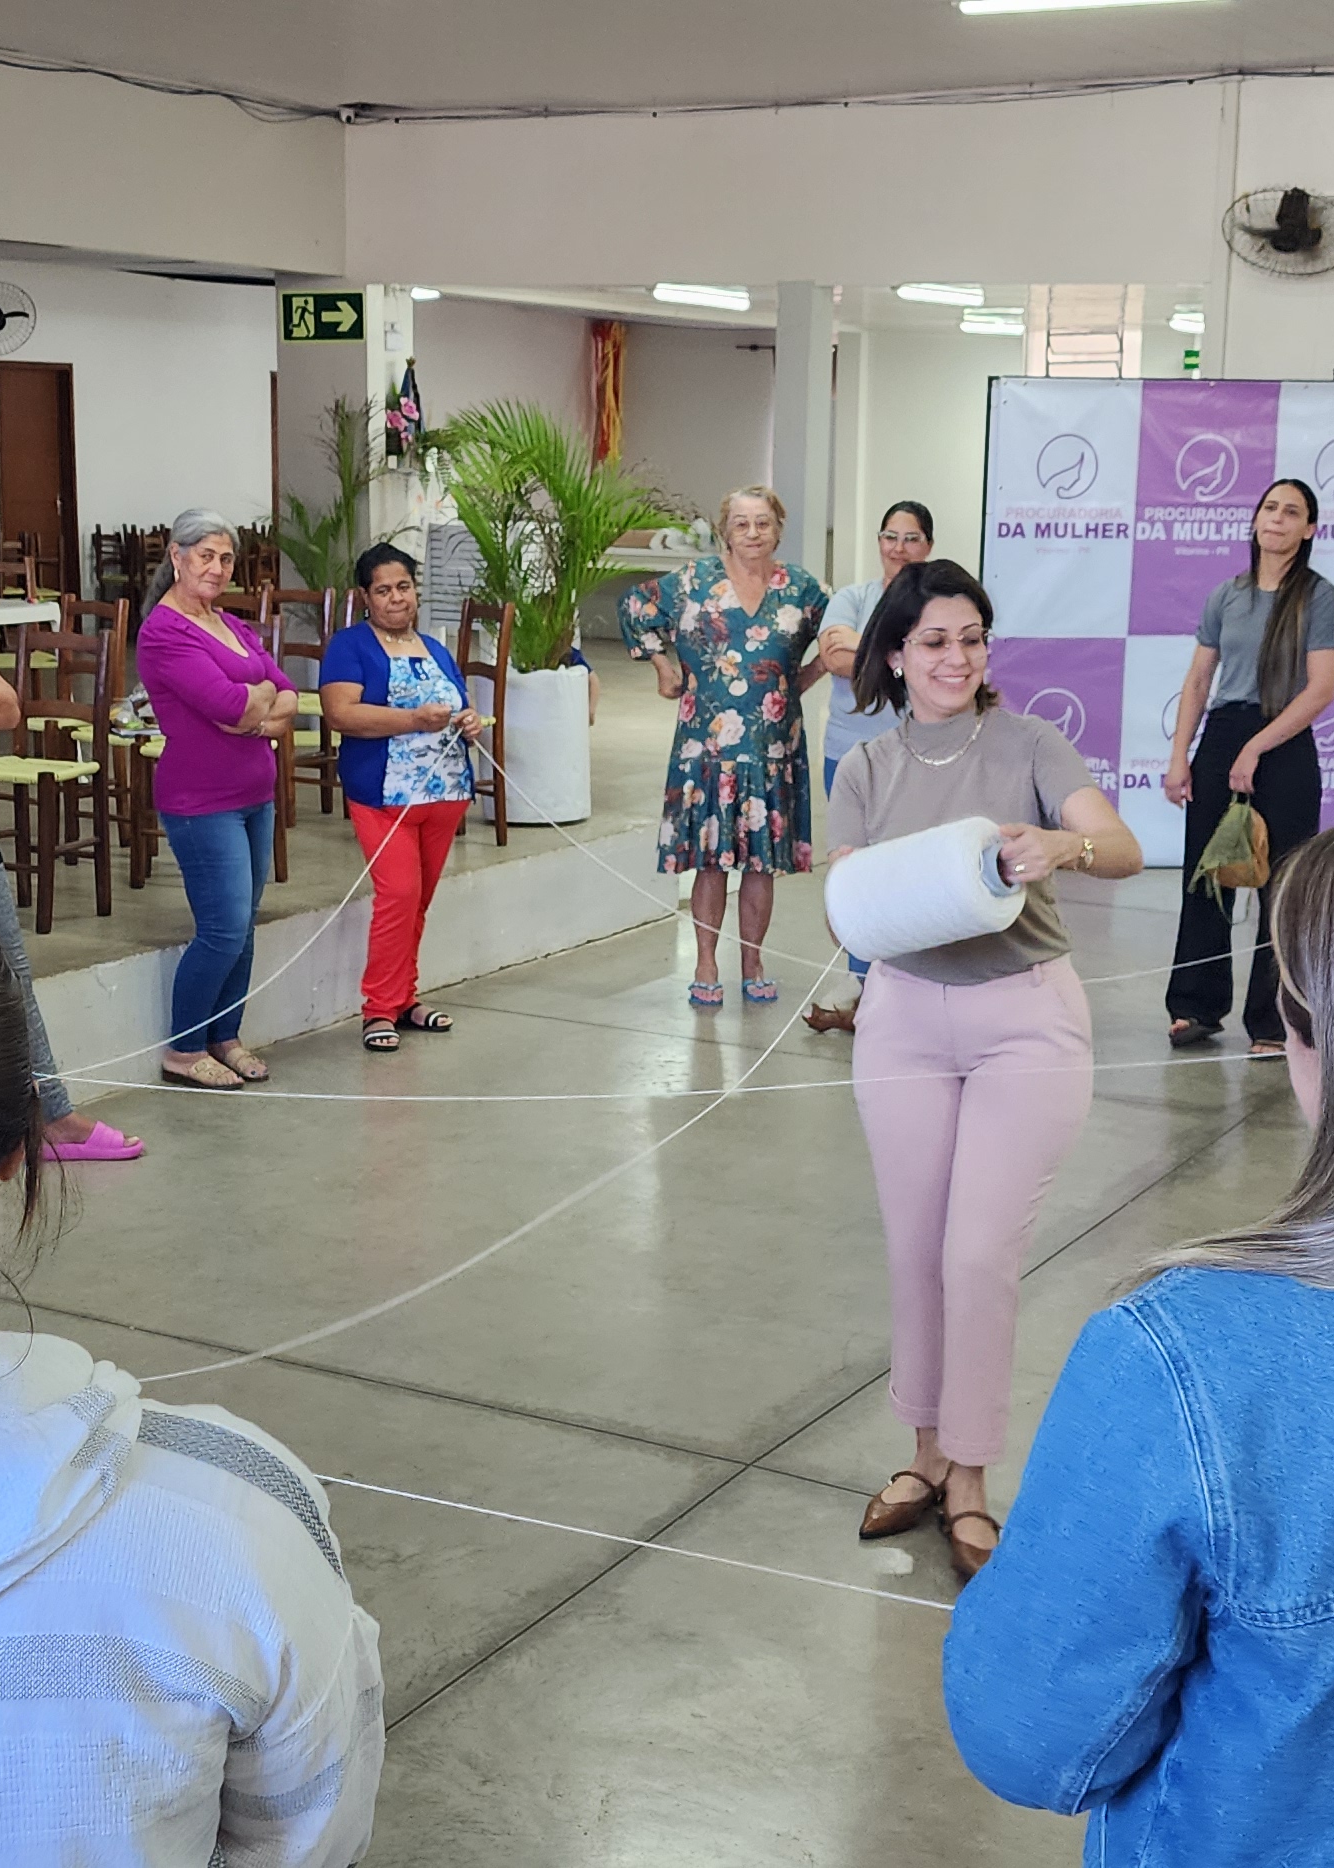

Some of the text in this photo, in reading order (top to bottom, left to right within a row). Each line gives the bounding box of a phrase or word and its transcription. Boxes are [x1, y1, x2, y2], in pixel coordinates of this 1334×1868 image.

[1144, 506, 1254, 521] PROCURADORI
[997, 522, 1130, 539] DA MULHER
[1135, 521, 1254, 541] DA MULHE
[1123, 773, 1152, 789] DA
